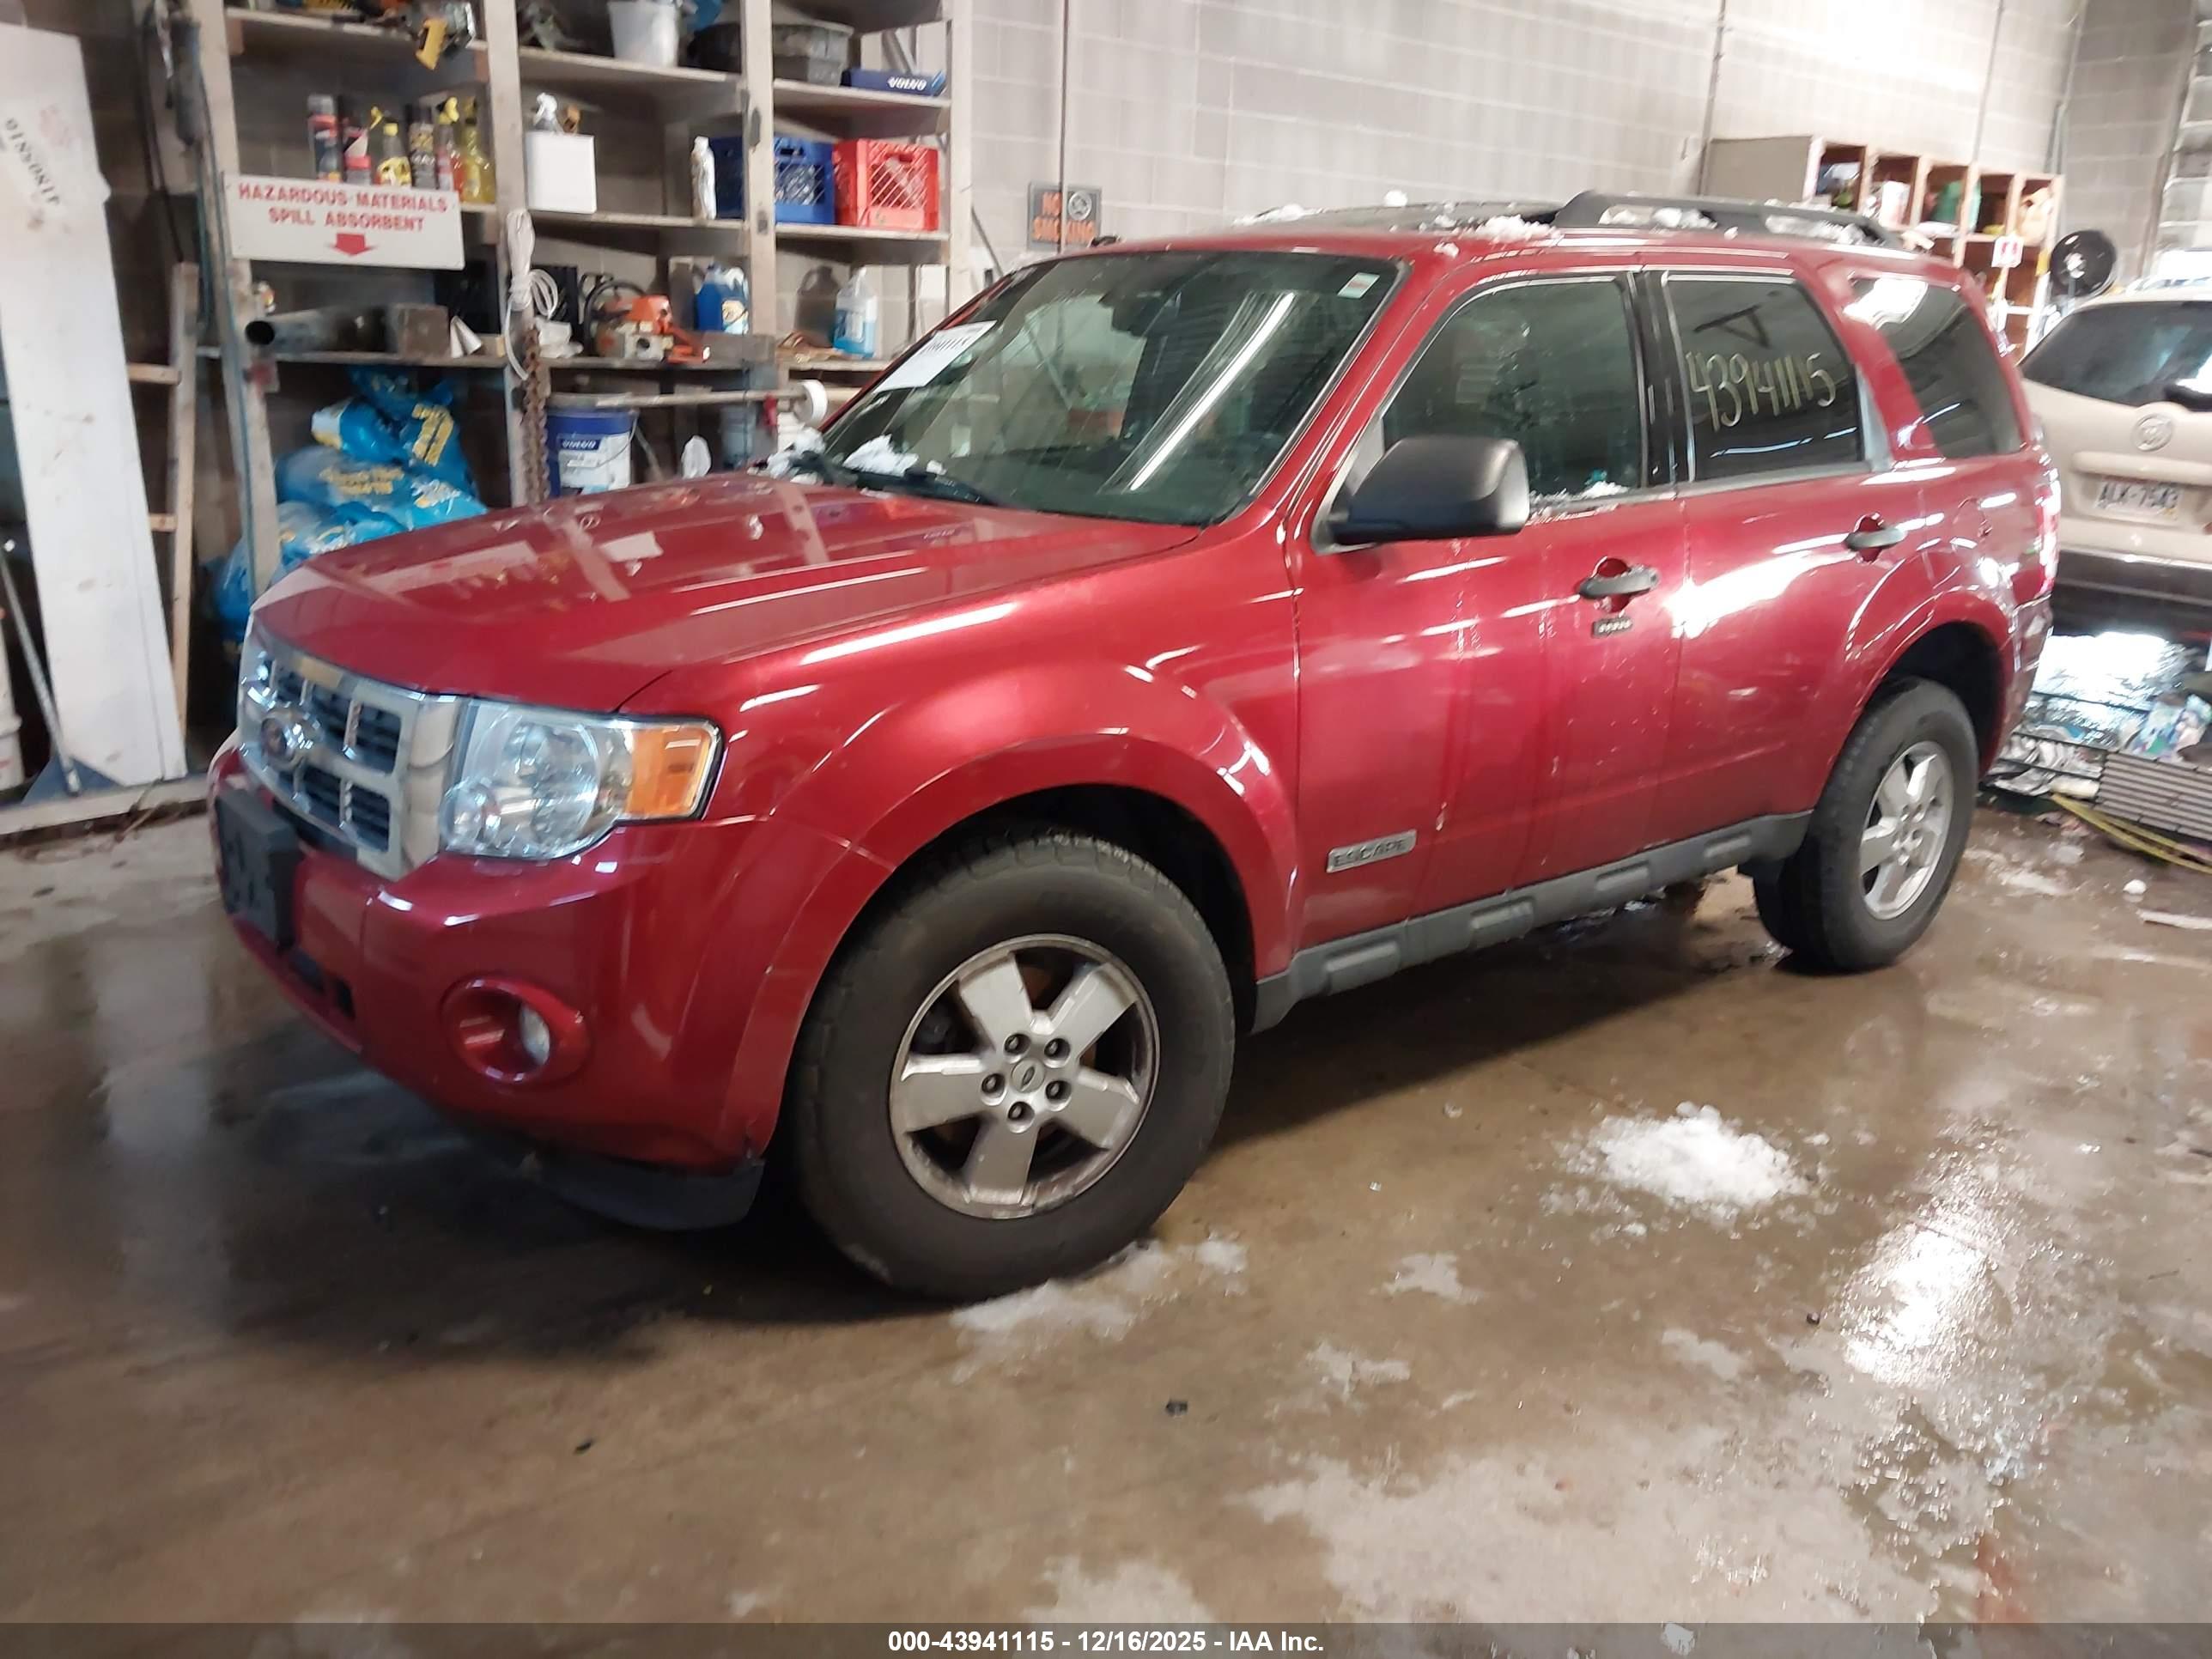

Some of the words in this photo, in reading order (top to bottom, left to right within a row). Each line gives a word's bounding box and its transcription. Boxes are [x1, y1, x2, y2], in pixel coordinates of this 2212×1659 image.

[238, 183, 348, 205] HAZARDOUS
[356, 192, 448, 213] MATERIALS
[268, 207, 316, 226] SPILL
[325, 210, 425, 231] ABSORBENT
